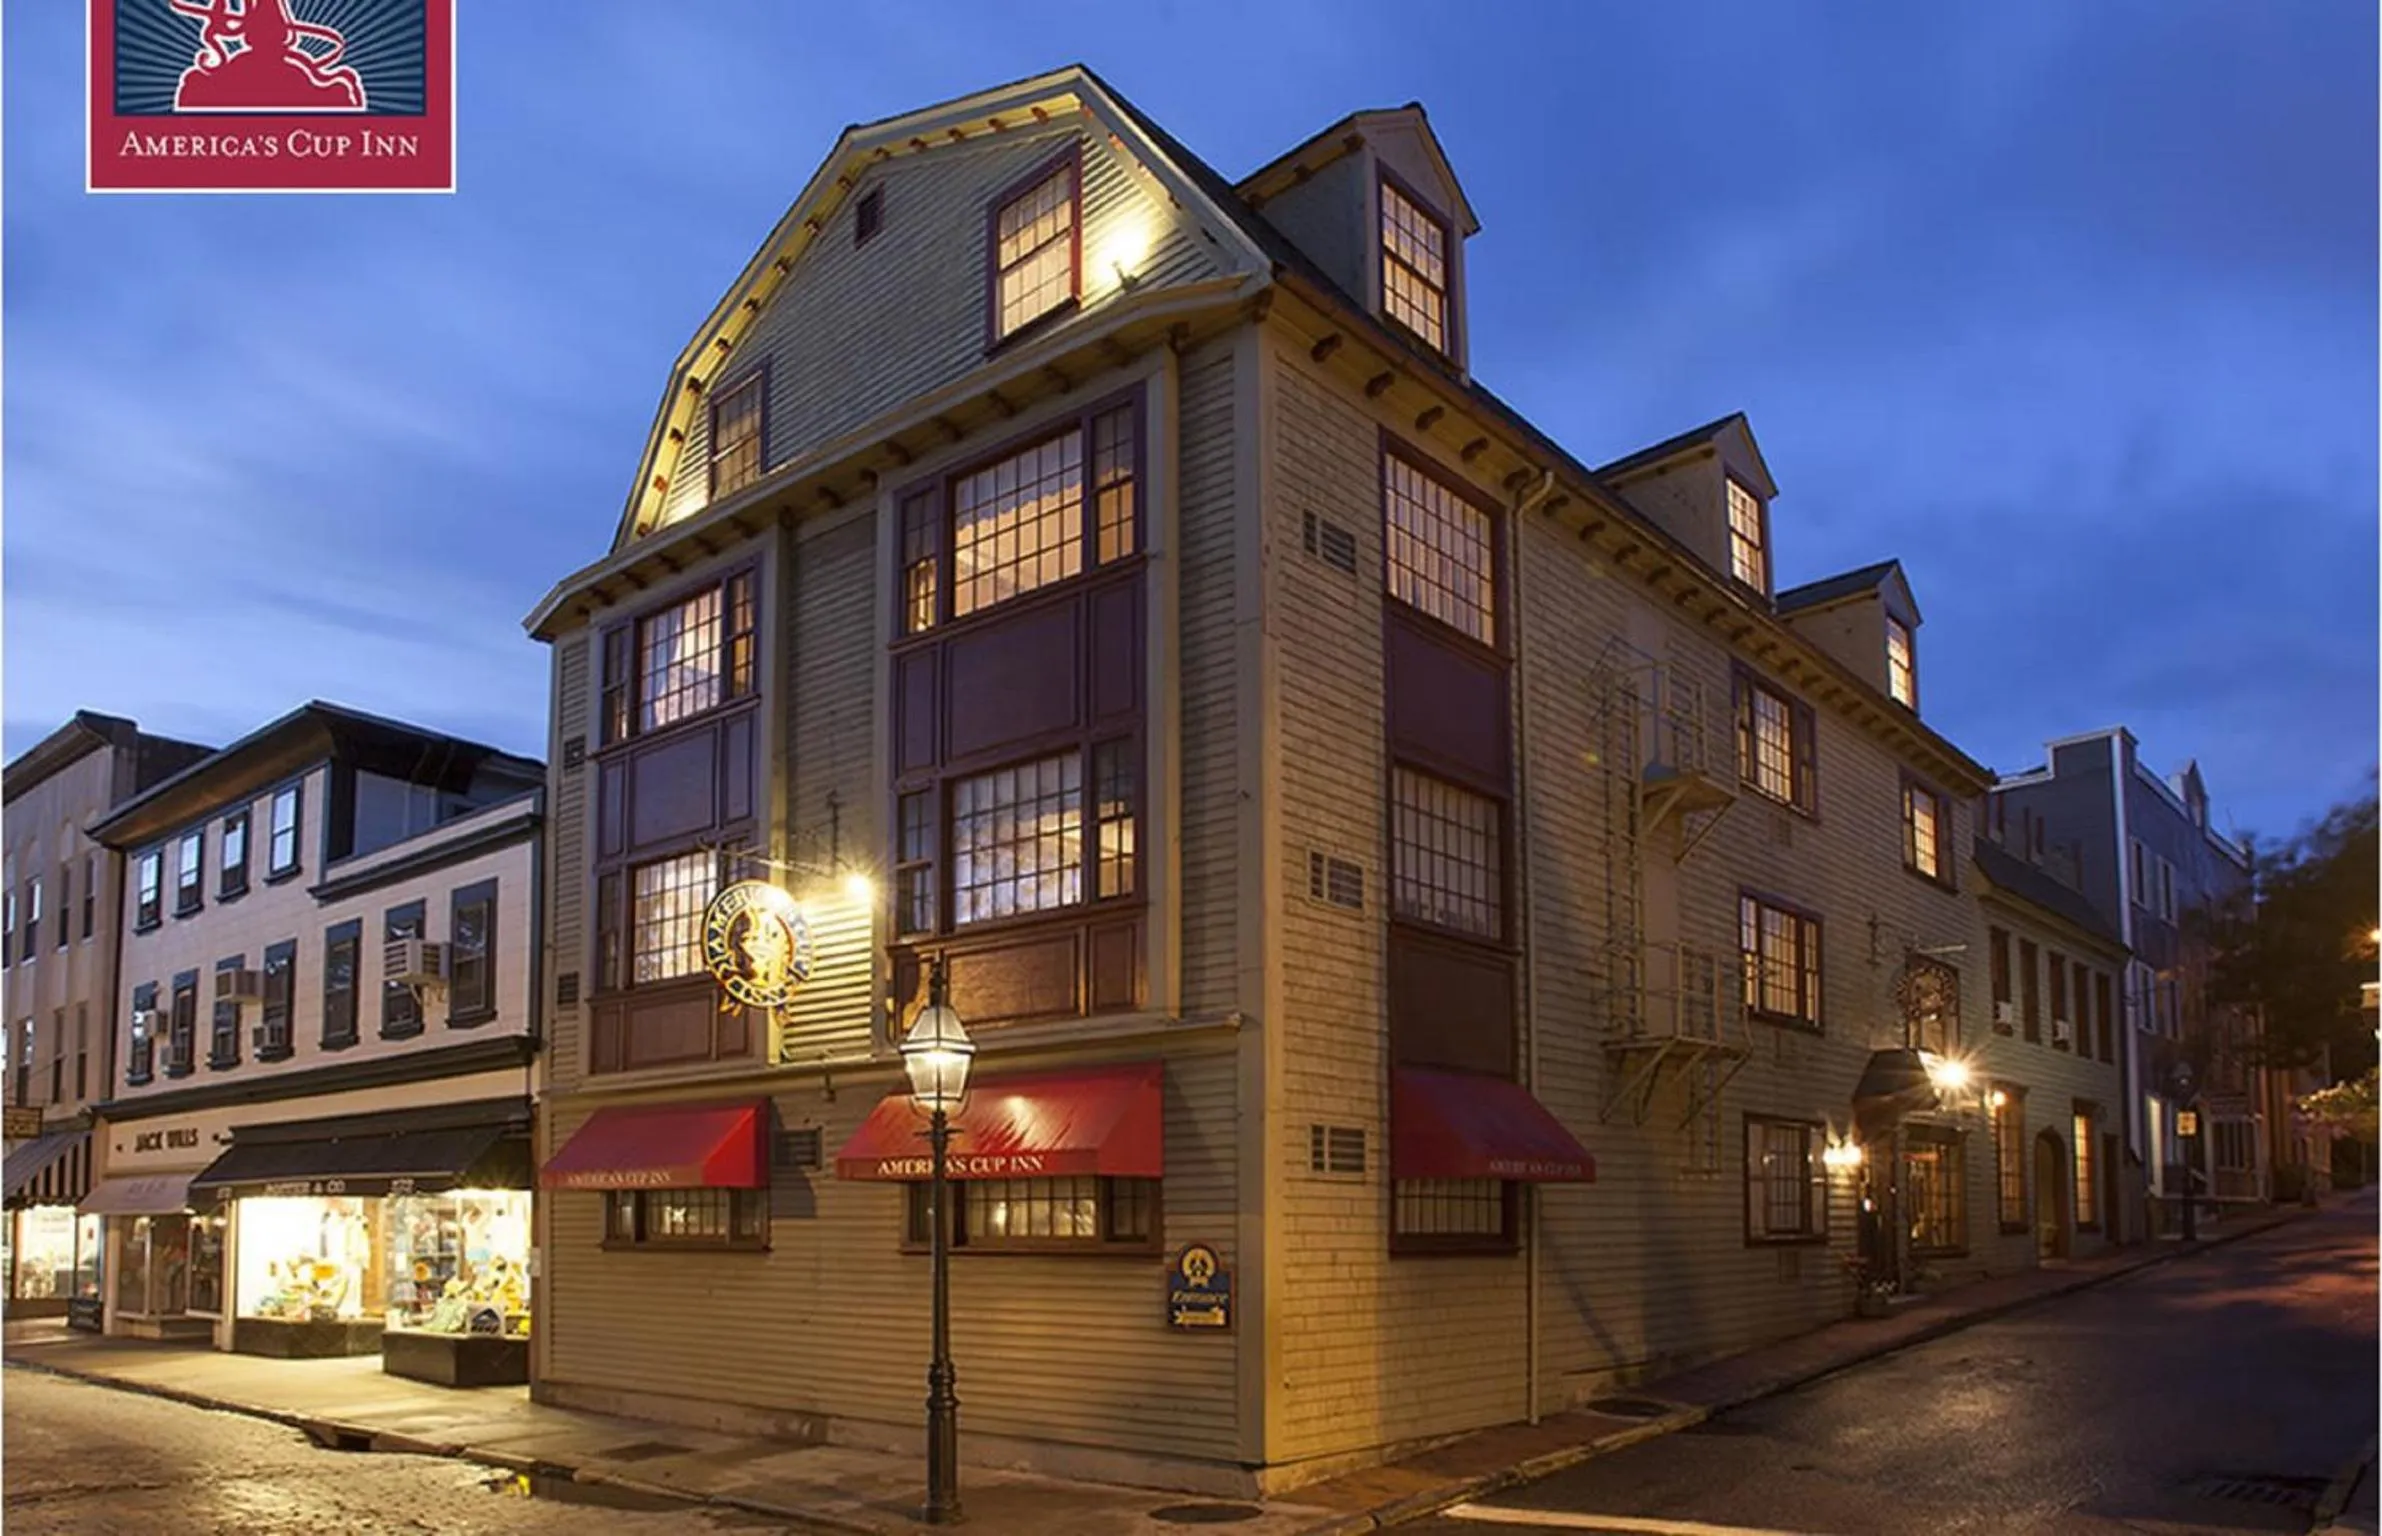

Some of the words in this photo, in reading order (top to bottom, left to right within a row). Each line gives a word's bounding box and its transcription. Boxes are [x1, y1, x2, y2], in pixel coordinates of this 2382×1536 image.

[876, 1156, 968, 1175] AMERIA'S
[969, 1155, 1006, 1173] CUP
[1010, 1154, 1044, 1172] INN
